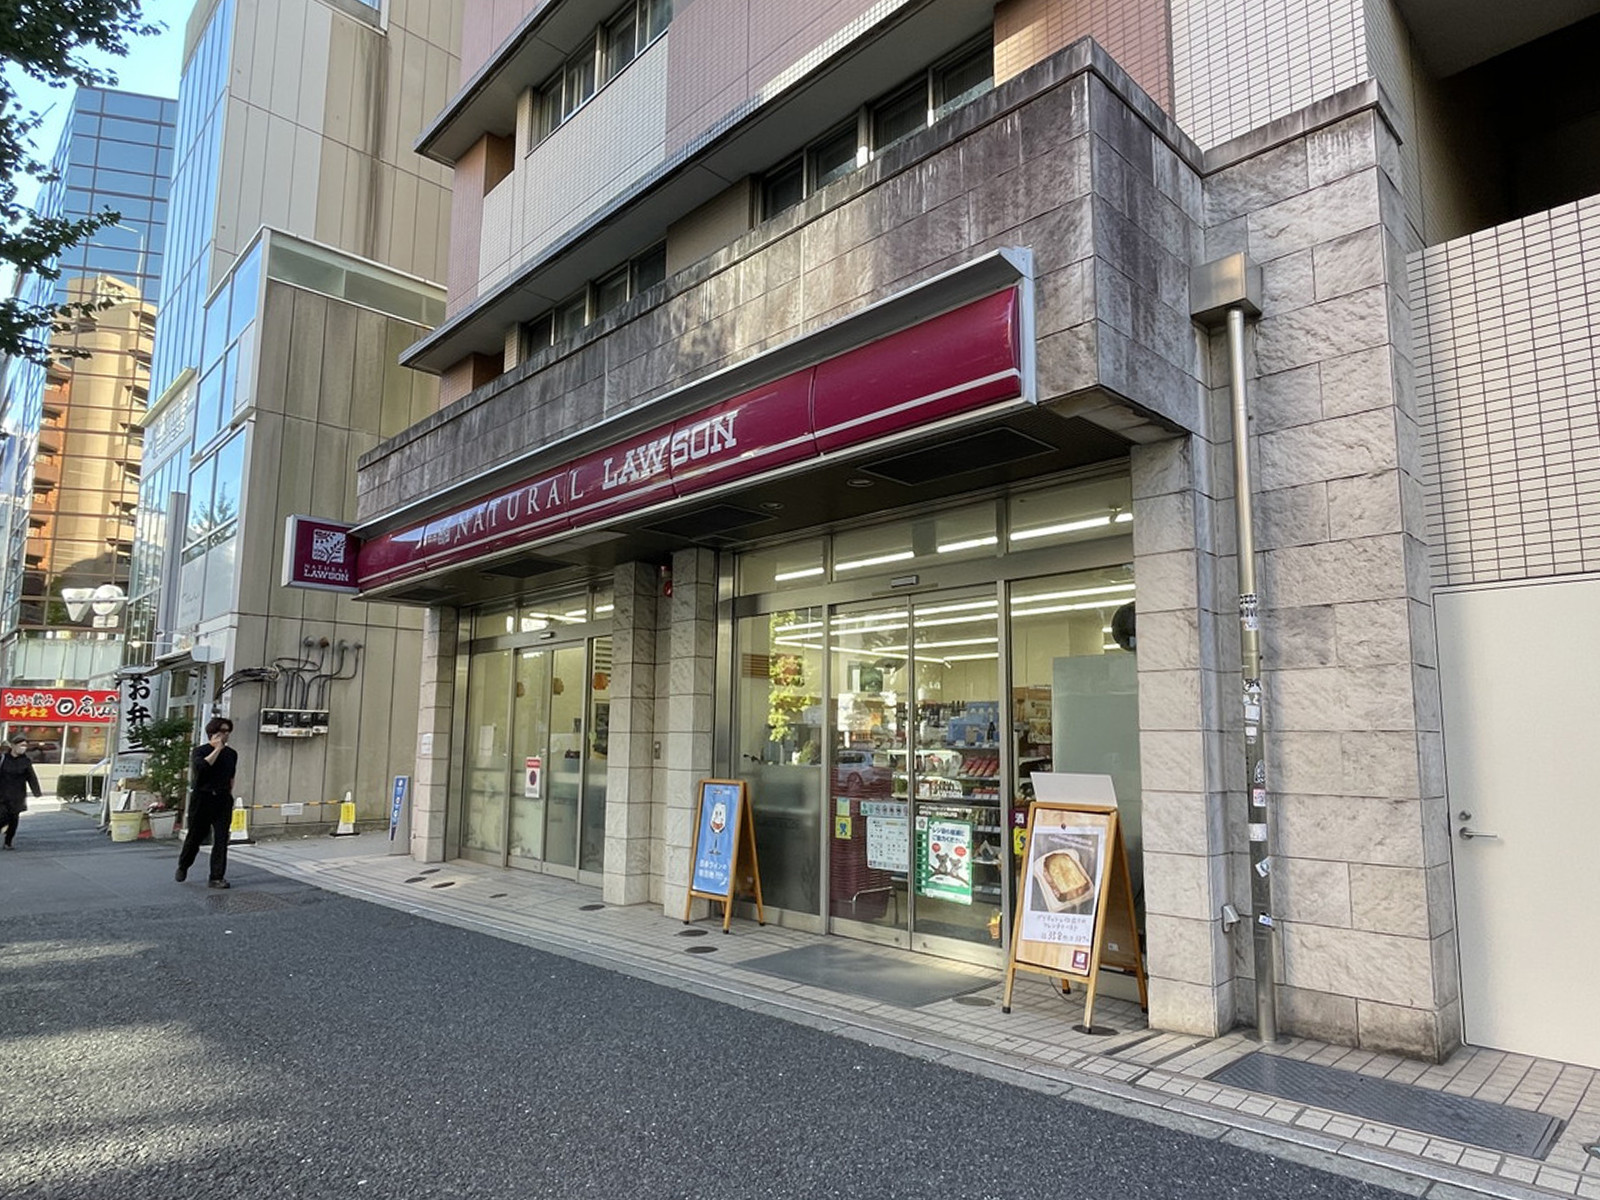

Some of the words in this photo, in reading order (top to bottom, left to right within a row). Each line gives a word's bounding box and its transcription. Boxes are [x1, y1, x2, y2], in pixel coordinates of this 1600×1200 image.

[454, 469, 584, 543] NATURAL
[602, 409, 740, 490] LAWSON
[303, 563, 348, 574] NATURAL
[303, 569, 349, 582] LAWSON
